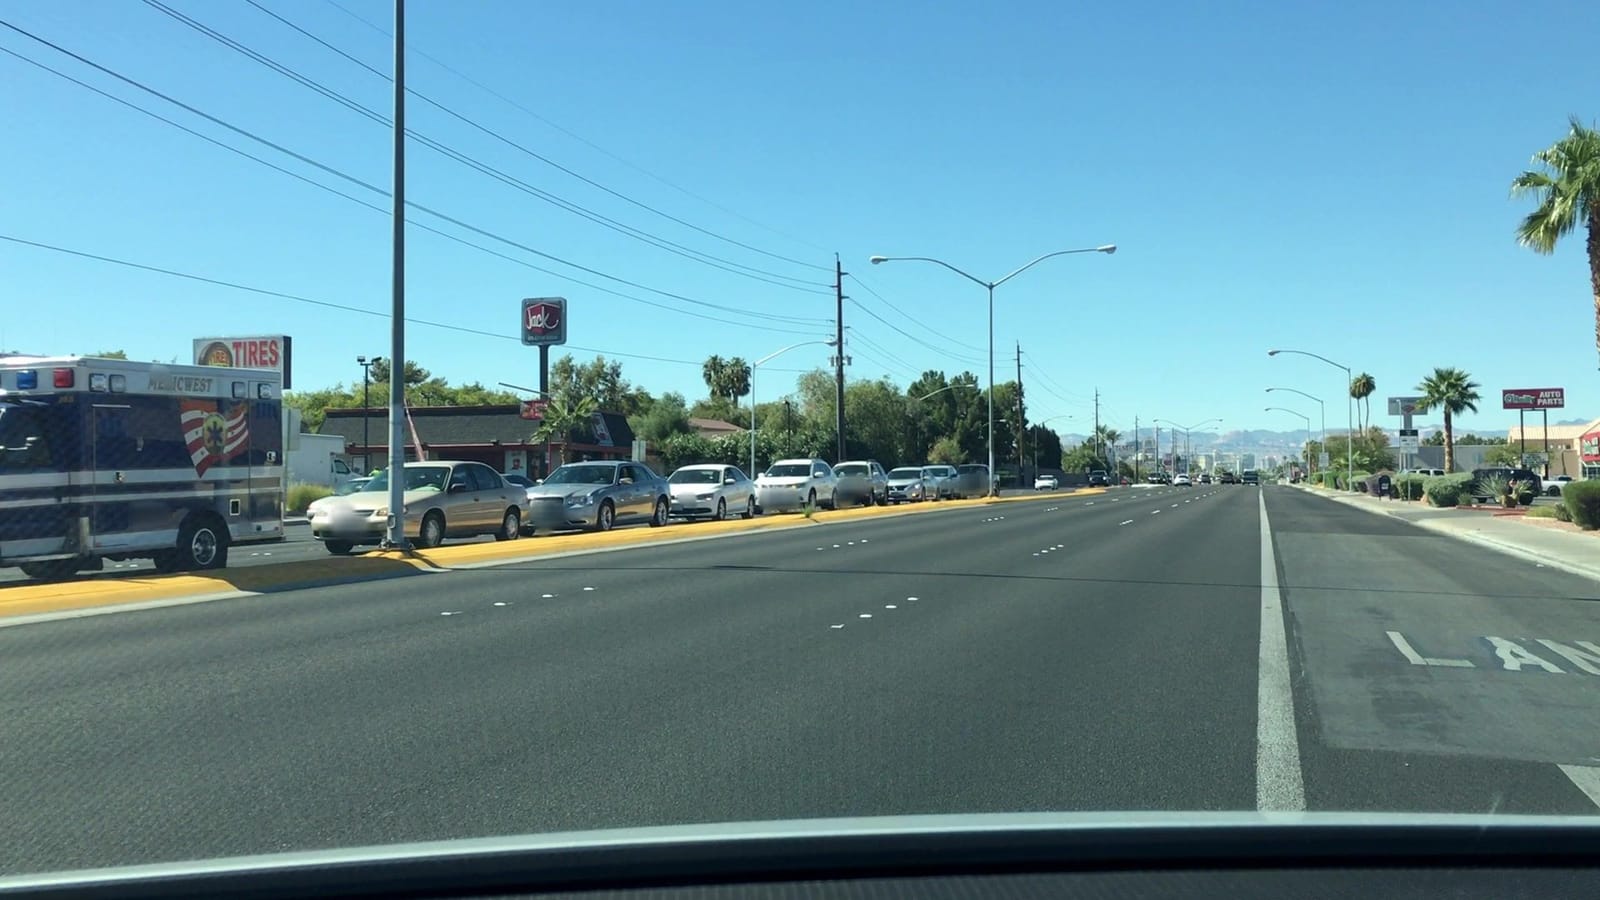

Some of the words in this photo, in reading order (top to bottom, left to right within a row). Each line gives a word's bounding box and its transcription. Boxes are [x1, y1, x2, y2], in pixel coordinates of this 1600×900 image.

[526, 306, 559, 330] Jack
[232, 340, 279, 368] TIRES
[1537, 398, 1563, 406] PARTS
